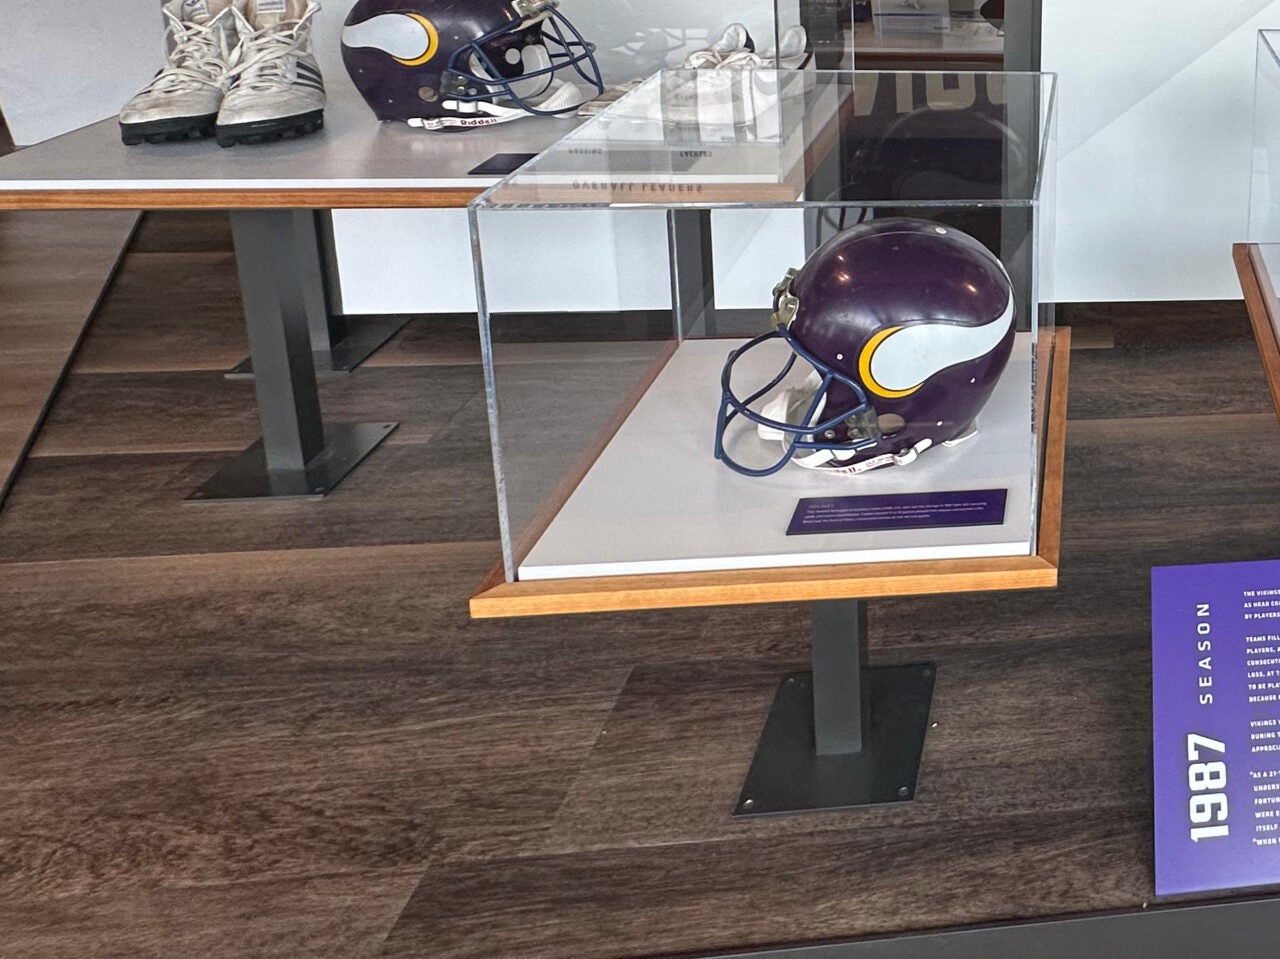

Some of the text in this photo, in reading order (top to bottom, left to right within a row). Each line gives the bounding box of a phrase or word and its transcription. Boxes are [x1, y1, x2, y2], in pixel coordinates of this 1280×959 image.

[460, 118, 497, 127] Riddell
[1197, 603, 1213, 704] SEASON
[1250, 719, 1276, 727] VIKINGS
[1187, 733, 1229, 843] 1987
